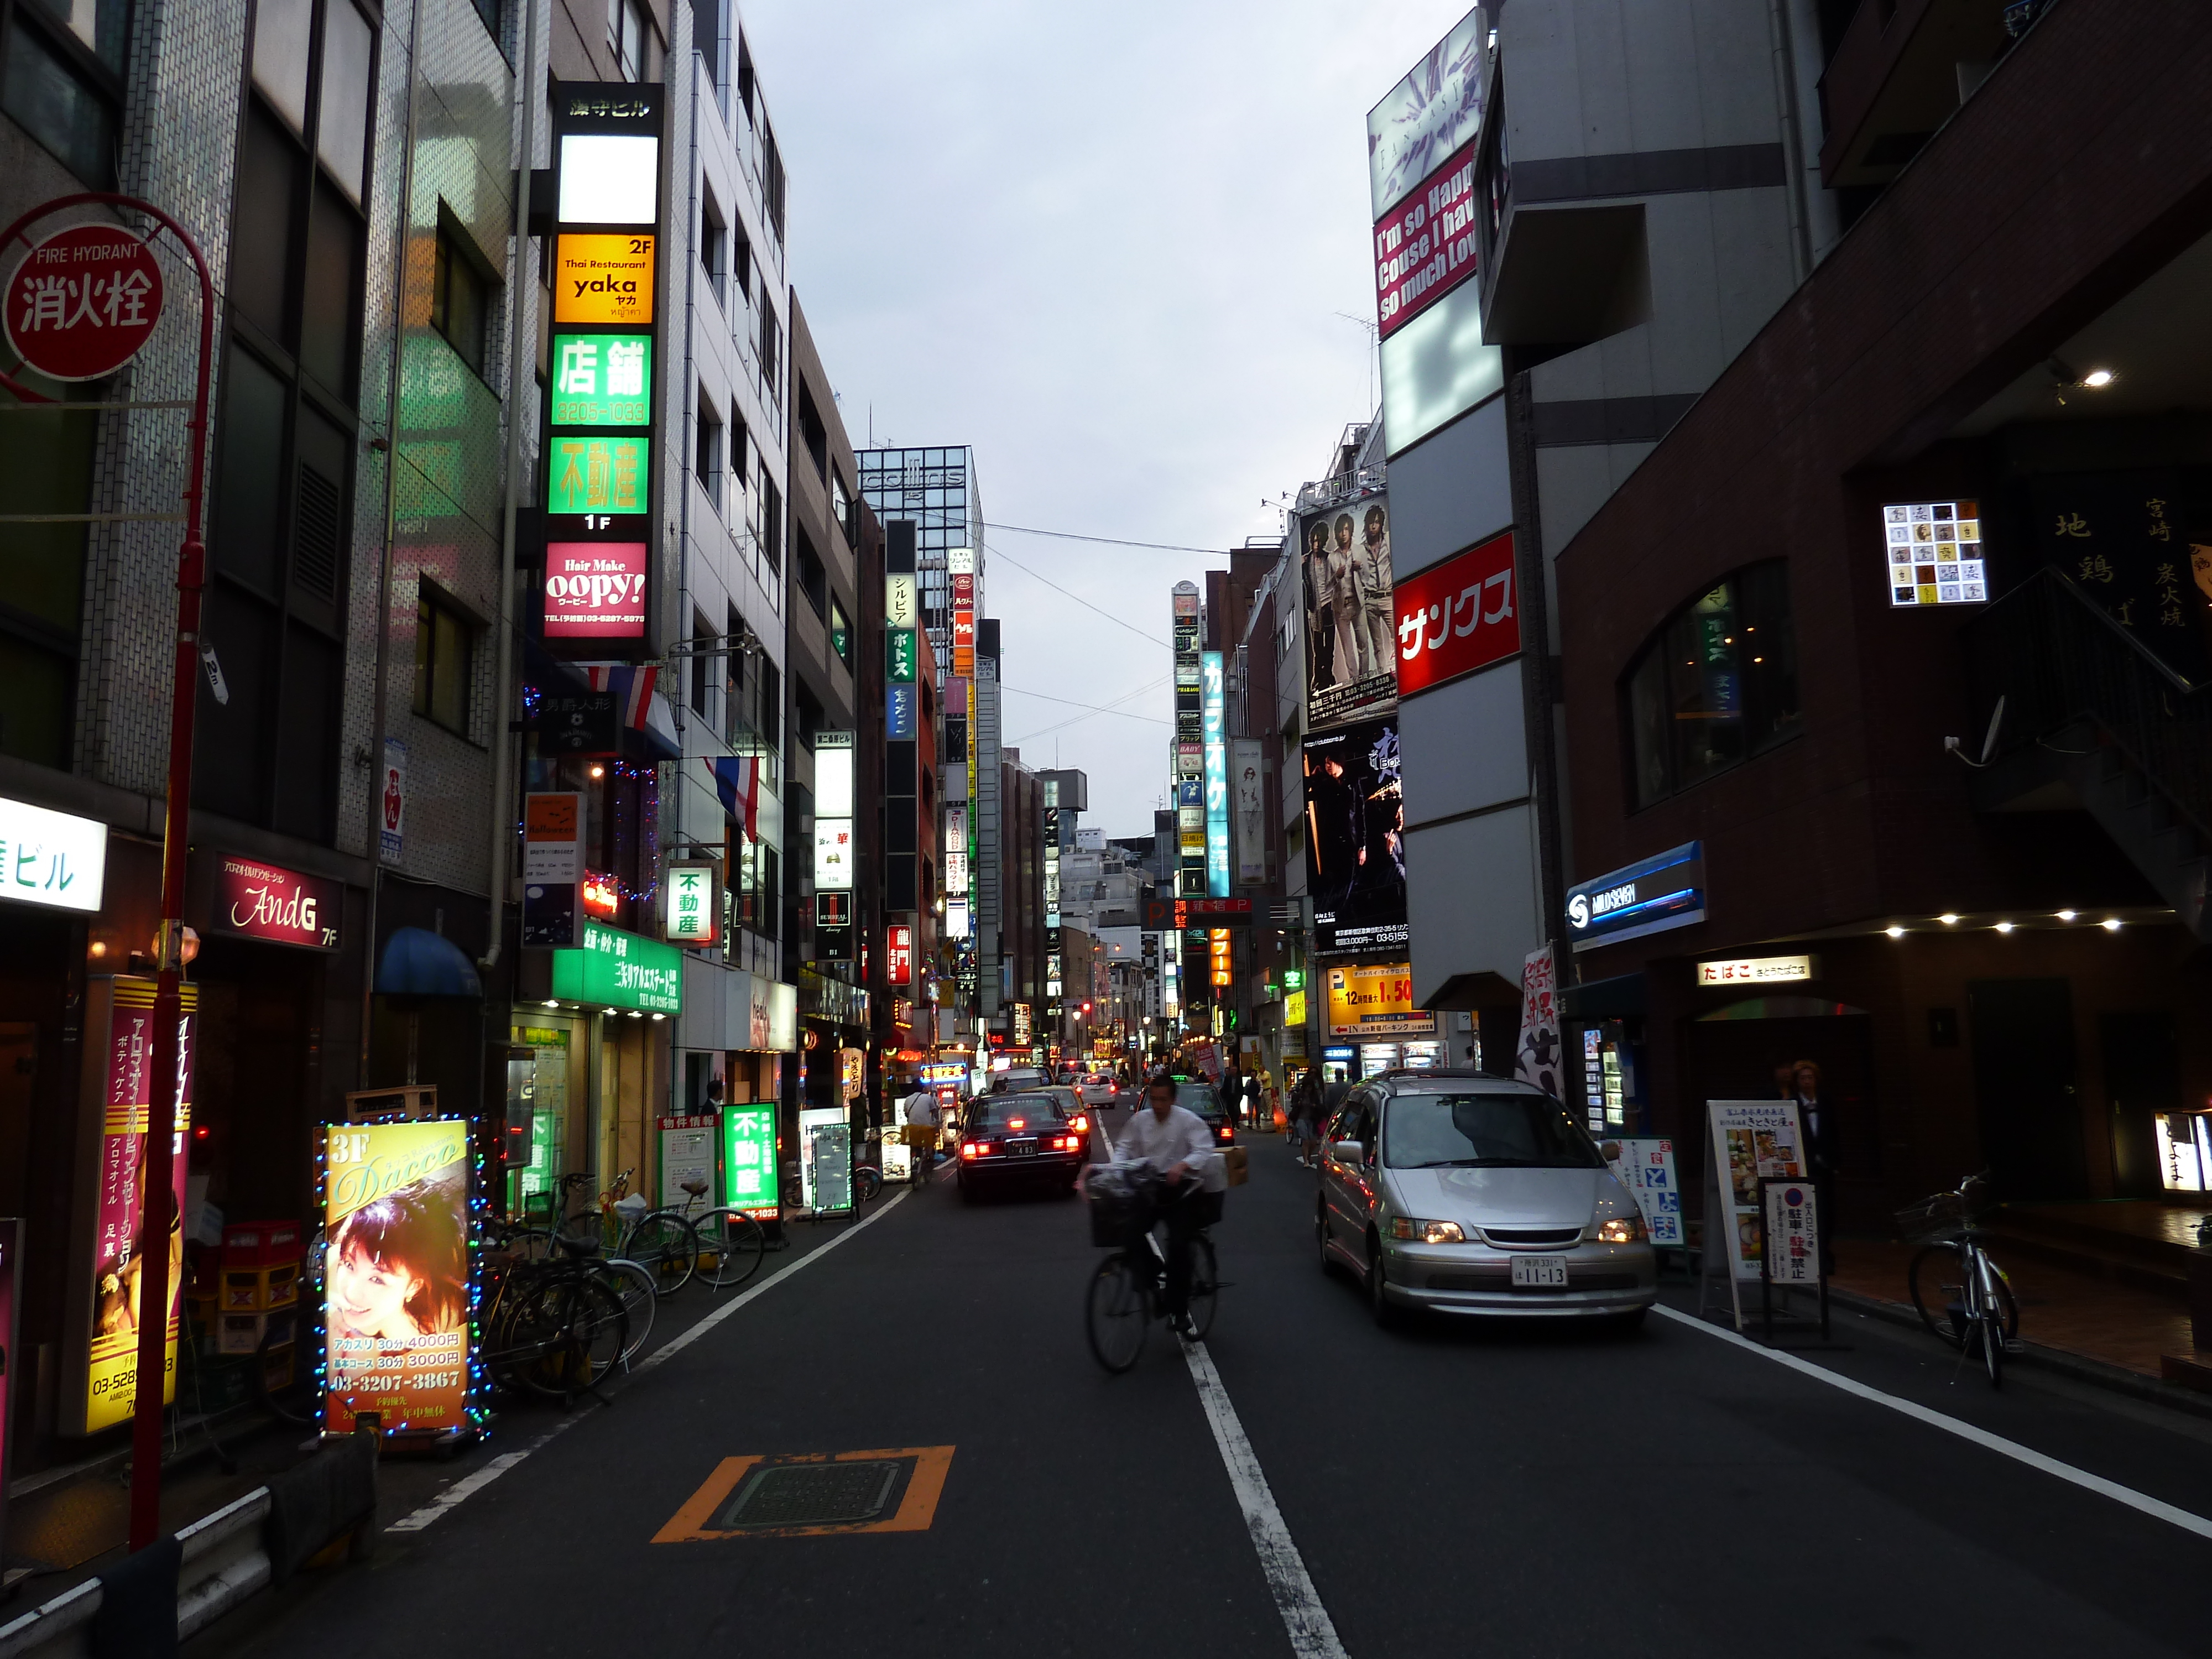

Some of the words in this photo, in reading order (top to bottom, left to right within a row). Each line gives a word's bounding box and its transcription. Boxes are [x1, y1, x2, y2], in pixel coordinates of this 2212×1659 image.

[1380, 79, 1460, 170] FANTASY
[629, 239, 651, 254] 2F
[1376, 223, 1402, 261] I'm
[1405, 204, 1425, 230] so
[36, 247, 67, 264] FIRE
[74, 243, 140, 262] HYDRANT
[565, 259, 587, 268] Thai
[590, 260, 646, 269] Restaurant
[1379, 234, 1430, 290] Couse
[1433, 225, 1440, 248] I
[20, 269, 152, 332] 消火栓
[574, 274, 637, 298] yaka
[615, 295, 637, 305] ヤカ
[1380, 293, 1399, 321] so
[1401, 252, 1447, 307] much
[557, 403, 644, 421] 3205-1033
[561, 442, 637, 507] 不動産
[2146, 499, 2171, 542] 宮崎
[565, 559, 591, 572] Hair
[593, 559, 626, 572] Make
[547, 573, 645, 608] oopy!
[895, 578, 907, 622] シルビア
[2155, 563, 2185, 627] 炭火焼
[1399, 568, 1512, 660] サンクス
[894, 633, 908, 676] ポトス
[1310, 692, 1342, 708] 初回三千円
[1204, 661, 1226, 811] カラオケ
[950, 816, 959, 850] DIAMOND
[1182, 834, 1204, 842] 日焼け
[224, 860, 285, 884] アロマオイルリラクゼーション
[232, 885, 317, 932] AndG
[679, 874, 700, 933] 不動産
[1593, 893, 1610, 914] MILD
[1610, 883, 1635, 910] SEVEN
[1175, 900, 1187, 928] 調整
[1192, 900, 1226, 912] 新宿
[1238, 899, 1247, 911] P
[321, 927, 337, 946] 7F
[896, 929, 910, 967] 龍門
[614, 961, 669, 994] 三矢リアルエステート
[1284, 970, 1301, 987] 空
[1330, 971, 1344, 989] P
[1704, 963, 1751, 980] たばこ
[1756, 964, 1806, 978] さとうたばこ店
[639, 993, 649, 1006] TEL
[1345, 991, 1378, 1005] 12時間最大
[1348, 1025, 1359, 1034] IN
[1371, 1023, 1409, 1032] 新宿パーキング
[663, 1115, 714, 1129] 物件情報
[332, 1133, 370, 1163] 3F
[411, 1134, 455, 1157] Relaxation
[733, 1112, 761, 1194] 不動産
[107, 1138, 121, 1205] アロマオイル
[333, 1142, 460, 1220] Dacco
[103, 1223, 116, 1258] 足裏
[1788, 1209, 1806, 1279] 駐車・駐輪禁止
[1526, 1269, 1563, 1282] 11-13
[334, 1339, 373, 1350] アカスリ
[378, 1339, 403, 1349] 30分
[408, 1334, 459, 1348] 4000円
[333, 1359, 373, 1369] 基本コース
[378, 1357, 403, 1368] 30分
[408, 1352, 459, 1366] 3000円
[333, 1370, 460, 1392] 03-3207-3867
[377, 1396, 408, 1407] 予約優先
[403, 1405, 446, 1420] 年中無休
